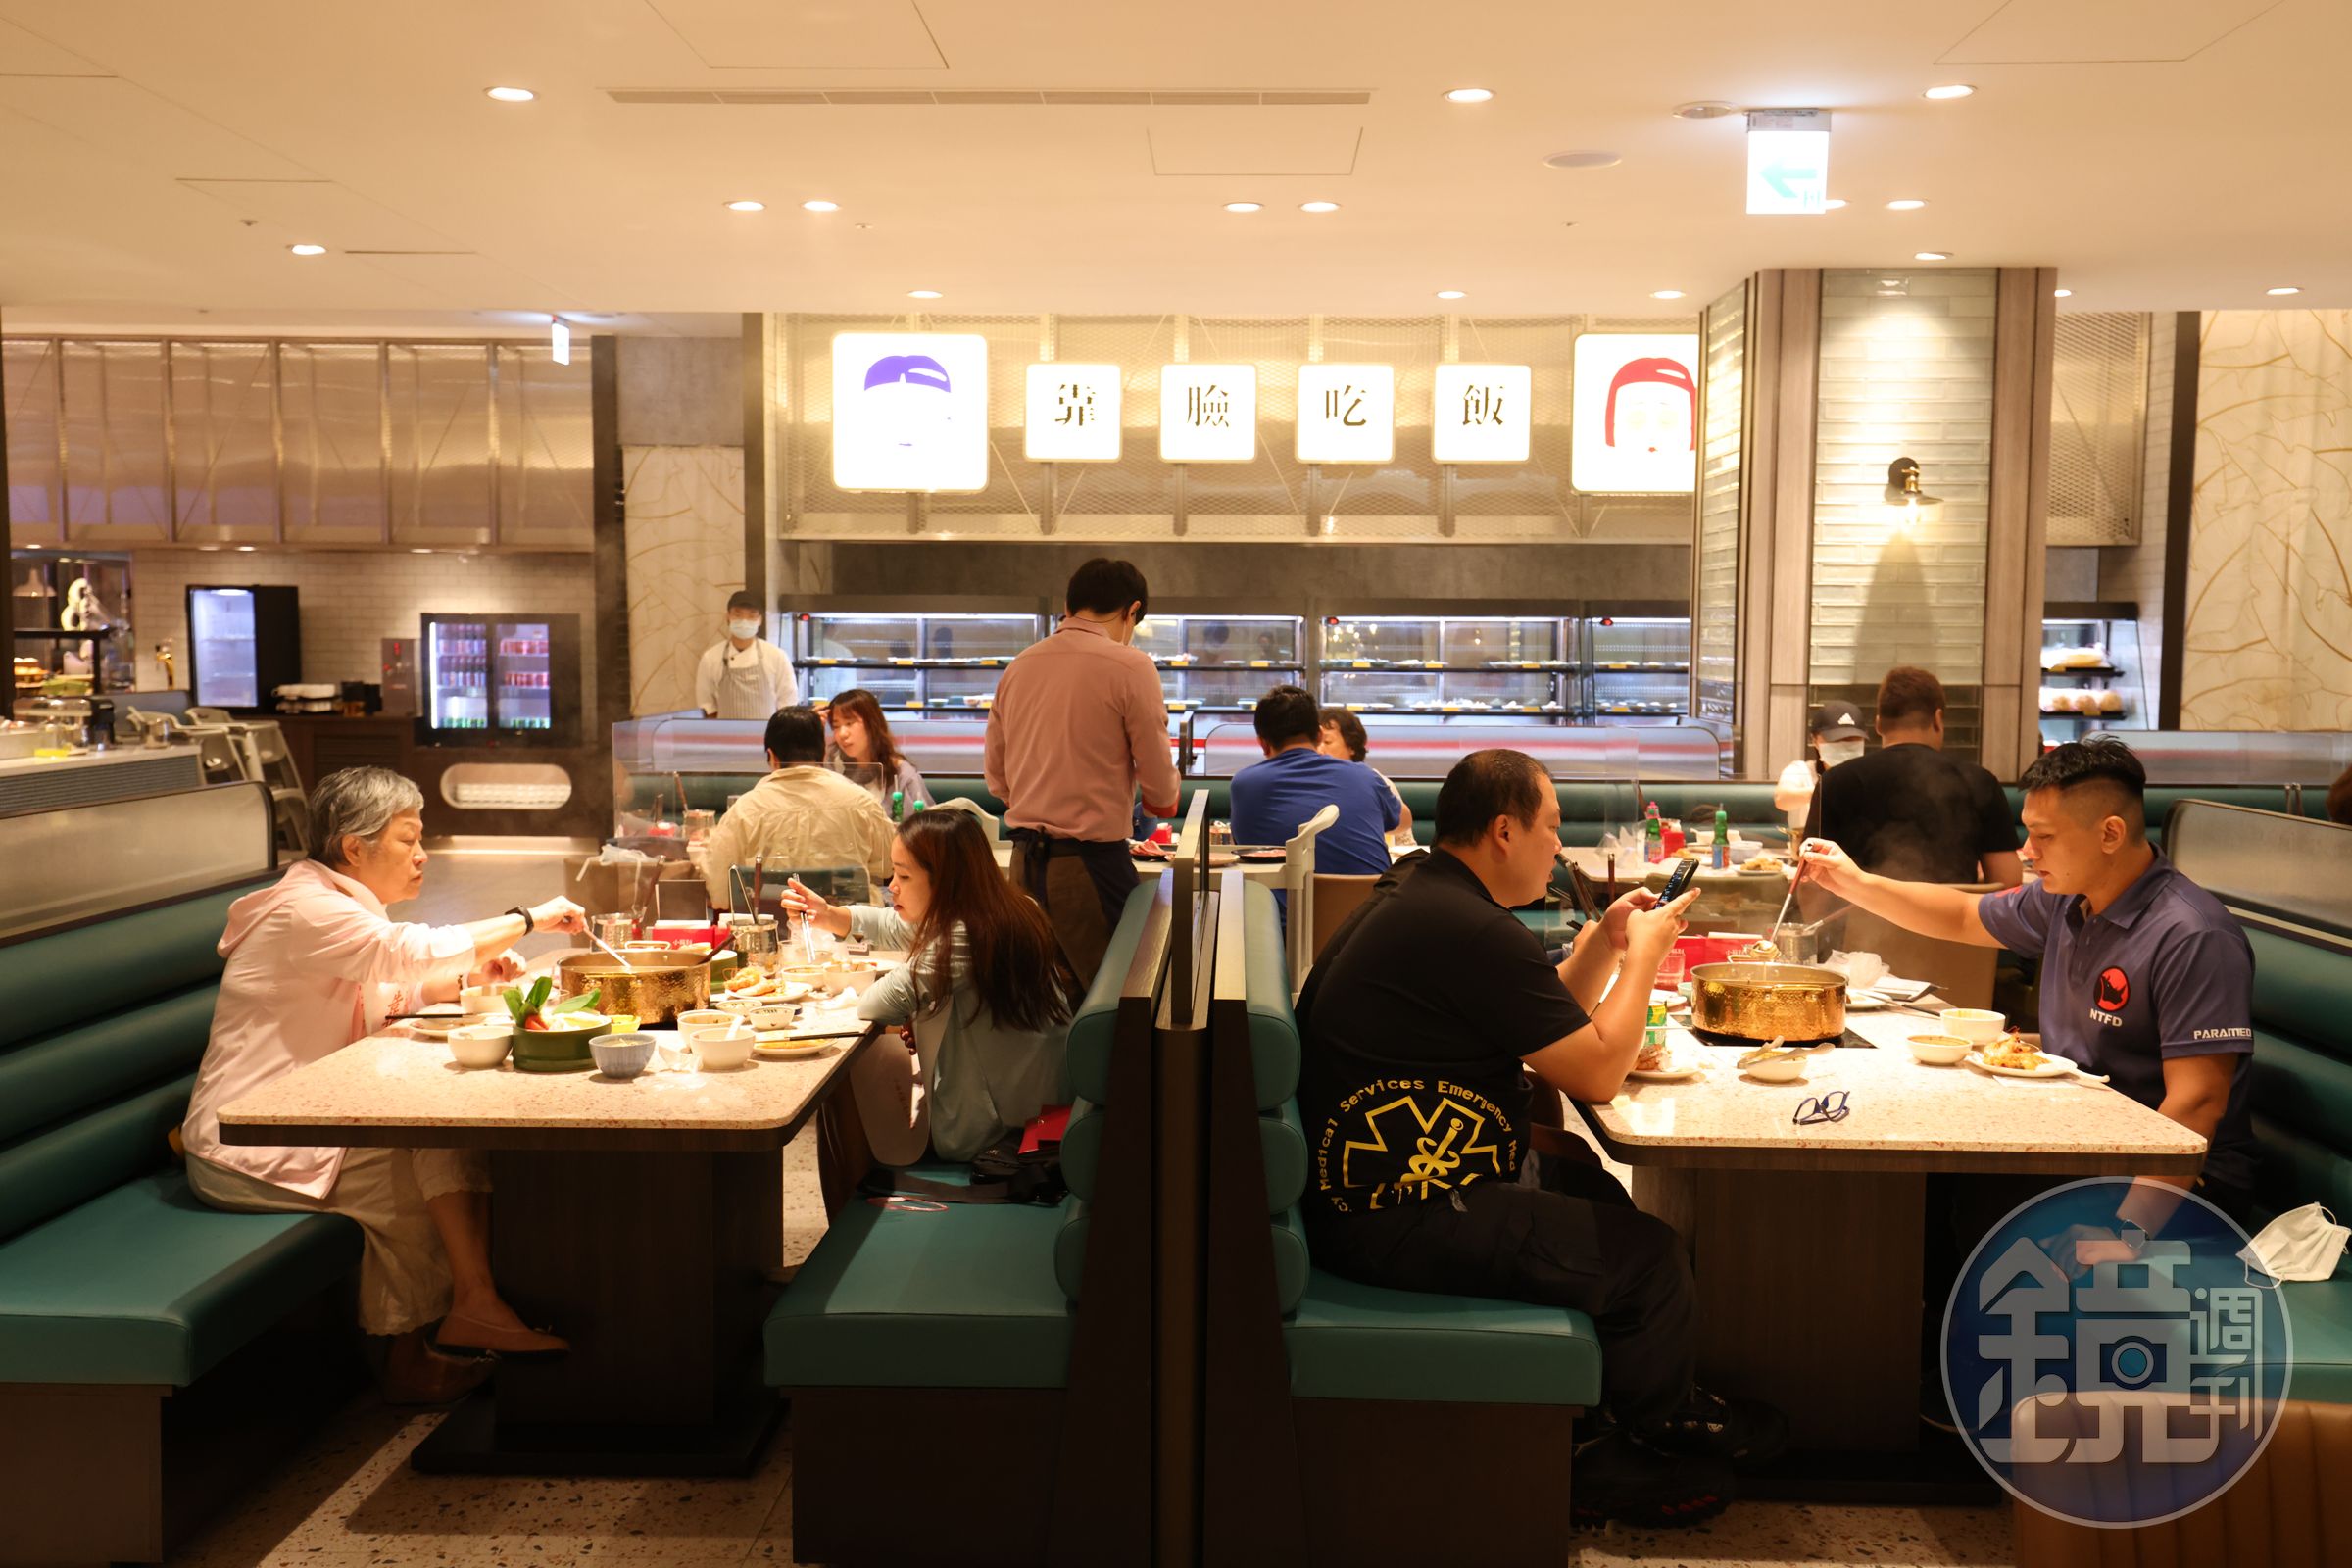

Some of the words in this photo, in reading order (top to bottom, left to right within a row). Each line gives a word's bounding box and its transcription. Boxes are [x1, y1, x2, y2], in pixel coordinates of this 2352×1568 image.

[2089, 1008, 2123, 1027] NTFD
[1317, 1117, 1339, 1191] Medical
[1339, 1079, 1425, 1113] Services
[1437, 1080, 1512, 1133] Emergency
